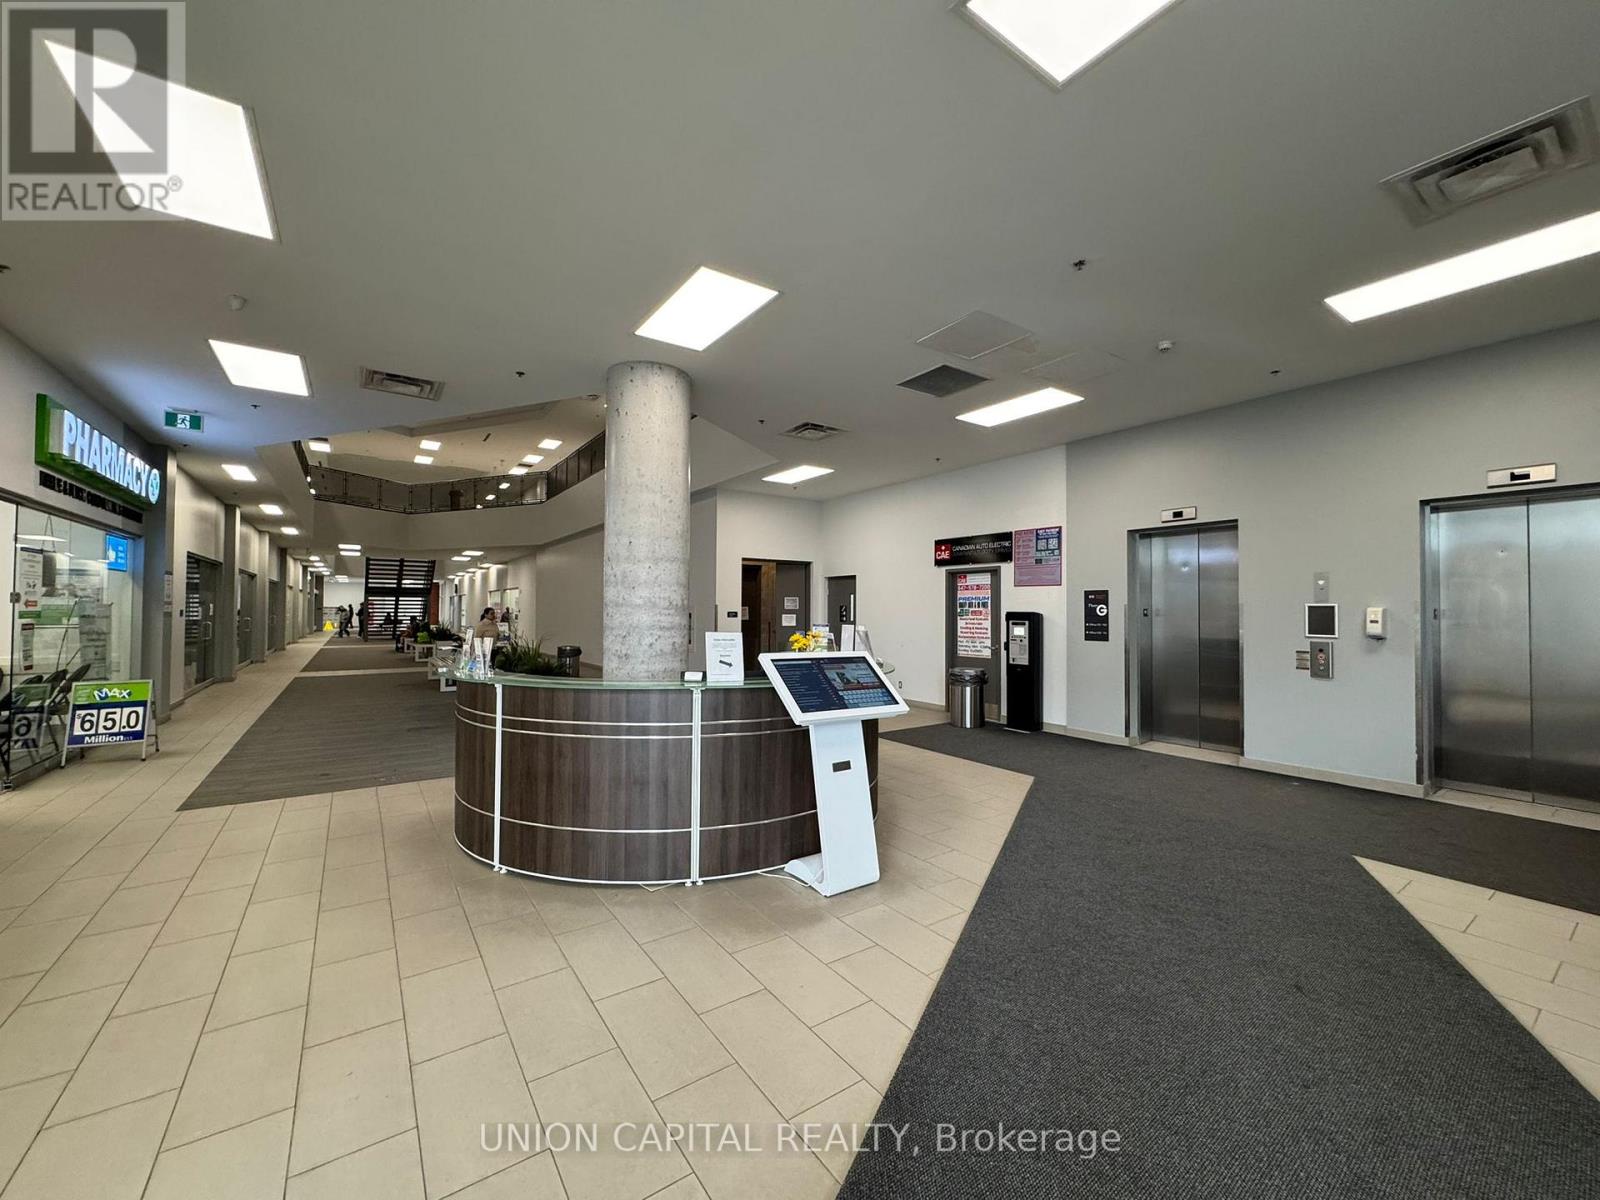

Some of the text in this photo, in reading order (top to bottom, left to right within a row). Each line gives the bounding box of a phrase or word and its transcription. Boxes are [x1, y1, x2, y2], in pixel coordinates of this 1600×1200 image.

[62, 409, 150, 498] PHARMACY
[952, 543, 975, 551] CANADIAN
[935, 550, 951, 560] CAE
[1096, 604, 1108, 616] G
[84, 734, 124, 744] Million
